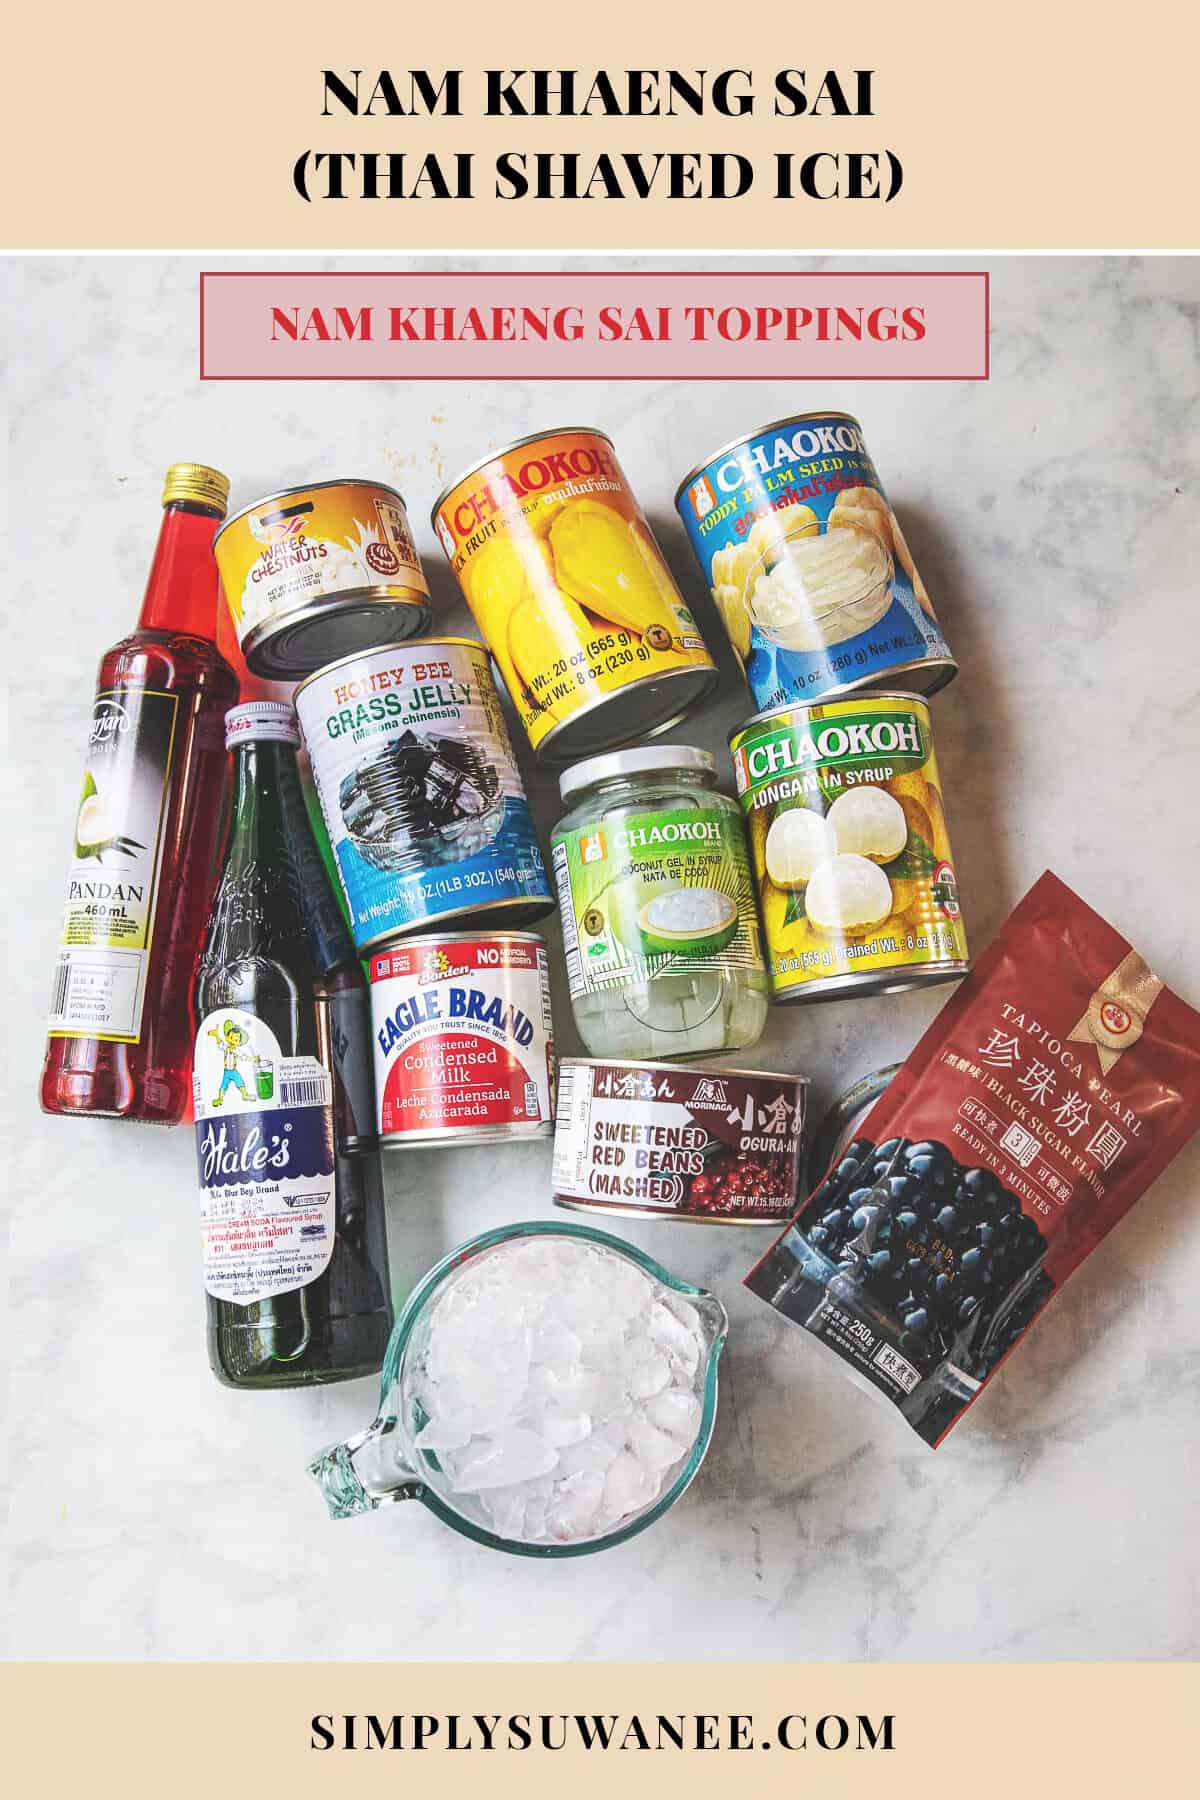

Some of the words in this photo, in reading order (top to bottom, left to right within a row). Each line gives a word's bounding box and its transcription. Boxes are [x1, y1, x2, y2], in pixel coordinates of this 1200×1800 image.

[454, 448, 617, 537] CHAOKOH
[699, 496, 738, 537] TODDY
[799, 457, 843, 479] SEED
[260, 534, 308, 562] WATER
[466, 520, 498, 555] FRUIT
[251, 543, 328, 583] CHESTNUTS
[553, 659, 568, 677] 20
[570, 652, 586, 667] oz
[587, 635, 615, 659] (565
[617, 630, 632, 647] g)
[576, 671, 585, 685] 8
[588, 664, 605, 679] oz
[605, 649, 633, 673] (230
[637, 643, 650, 661] g)
[334, 668, 405, 705] HONEY
[412, 662, 453, 681] BEE
[793, 676, 805, 691] 10
[808, 670, 823, 684] oz
[326, 693, 402, 739] GRASS
[409, 683, 472, 711] JELLY
[402, 707, 461, 726] chinensis)
[749, 722, 921, 779] CHAOKOH
[752, 776, 818, 810] LONGAN
[823, 774, 841, 789] IN
[846, 767, 894, 786] SYRUP
[612, 822, 722, 849] CHAOKOH
[495, 867, 515, 885] (540
[643, 870, 667, 883] NATA
[670, 869, 681, 879] DE
[667, 857, 684, 868] GEL
[688, 856, 695, 865] IN
[699, 856, 722, 865] SYRUP
[69, 881, 144, 903] PANDAN
[84, 905, 106, 916] 460
[108, 905, 128, 918] mL
[907, 936, 914, 949] 8
[916, 937, 928, 948] oz
[418, 965, 470, 986] Borden
[477, 949, 499, 965] NO
[378, 990, 442, 1057] EAGLE
[450, 988, 534, 1047] BRAND
[441, 1021, 466, 1029] TRUST
[468, 1022, 491, 1036] SINCE
[420, 1038, 478, 1053] Sweetened
[1001, 1002, 1084, 1079] TAPIOCA
[404, 1048, 498, 1070] Condensed
[431, 1068, 472, 1084] Milk
[396, 1094, 428, 1109] Leche
[431, 1088, 511, 1105] Condensada
[418, 1103, 489, 1121] Azucarada
[684, 1101, 732, 1111] MORINAGA
[978, 1028, 1128, 1172] 珍珠粉圓
[986, 1077, 1031, 1121] BLACK
[1028, 1116, 1078, 1159] SUGAR
[593, 1121, 707, 1151] SWEETENED
[1011, 1132, 1023, 1147] 3
[201, 1122, 291, 1181] Hale's
[592, 1145, 626, 1167] RED
[635, 1149, 704, 1176] BEANS
[952, 1122, 987, 1155] READY
[987, 1154, 1000, 1167] IN
[1007, 1172, 1051, 1216] MINUTES
[588, 1169, 683, 1202] (MASHED)
[849, 1320, 875, 1347] 250g
